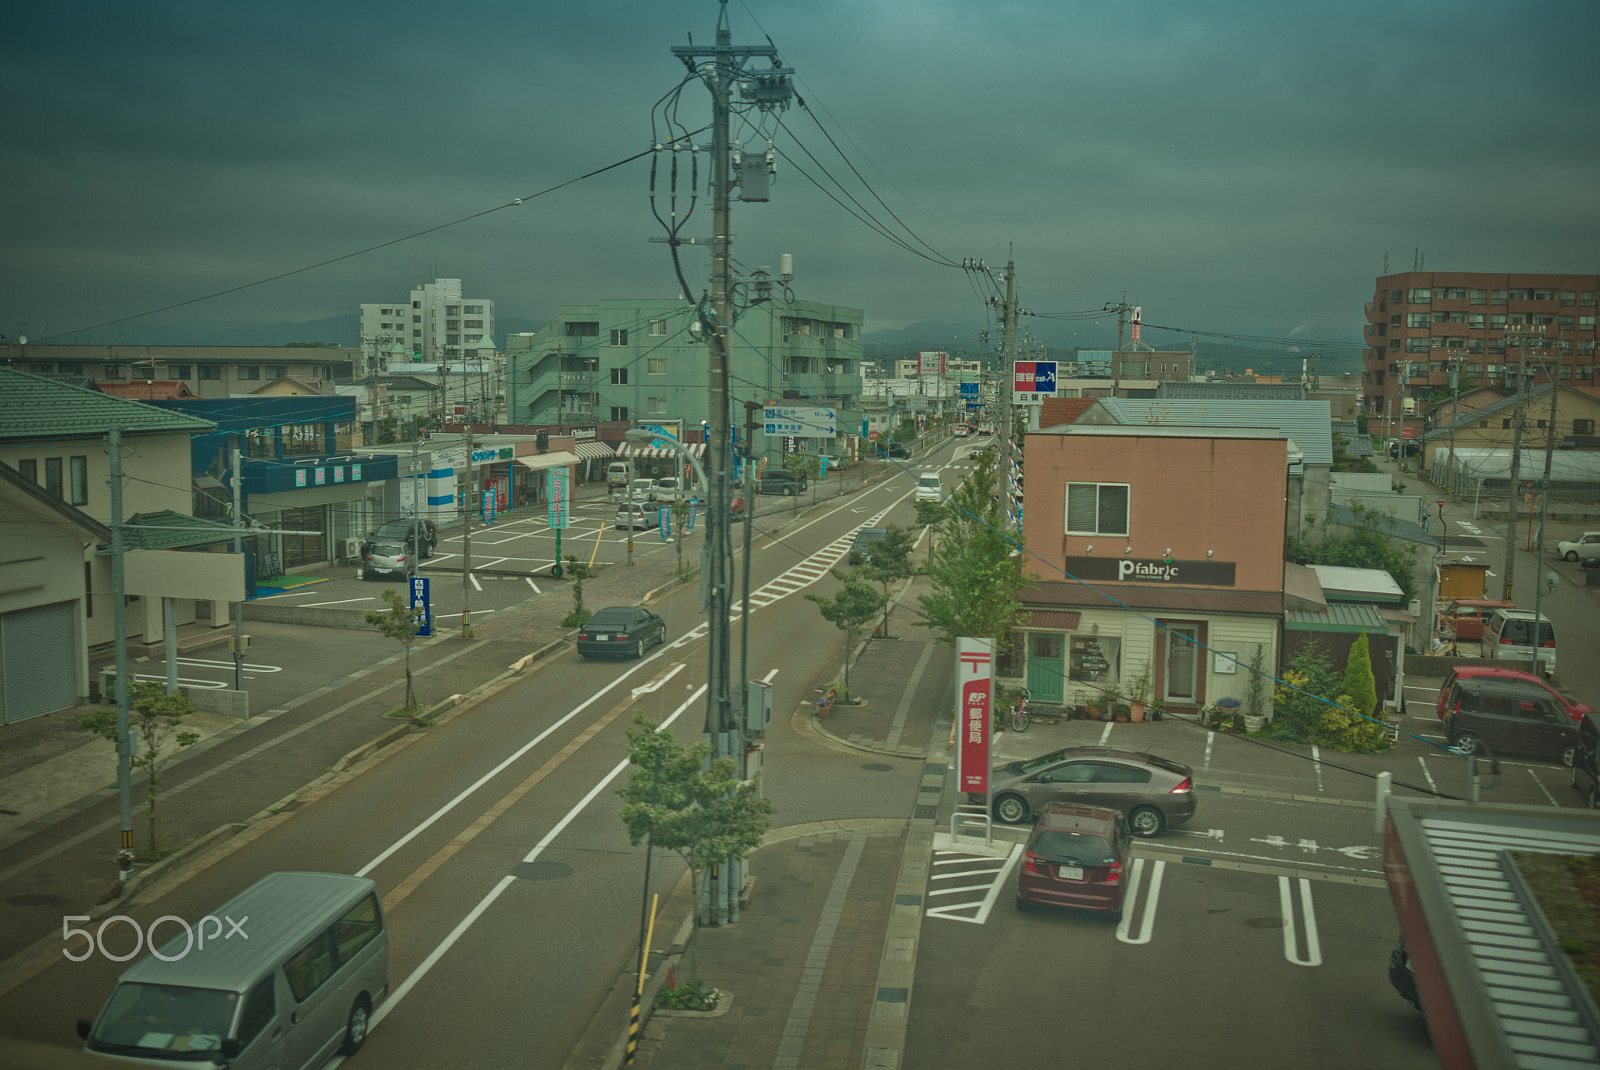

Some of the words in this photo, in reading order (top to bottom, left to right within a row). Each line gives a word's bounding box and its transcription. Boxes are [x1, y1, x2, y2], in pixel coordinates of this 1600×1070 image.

[1015, 372, 1035, 382] 理容
[297, 466, 360, 484] ミルキー
[552, 479, 564, 526] ミルキー
[968, 707, 983, 744] 郵便局
